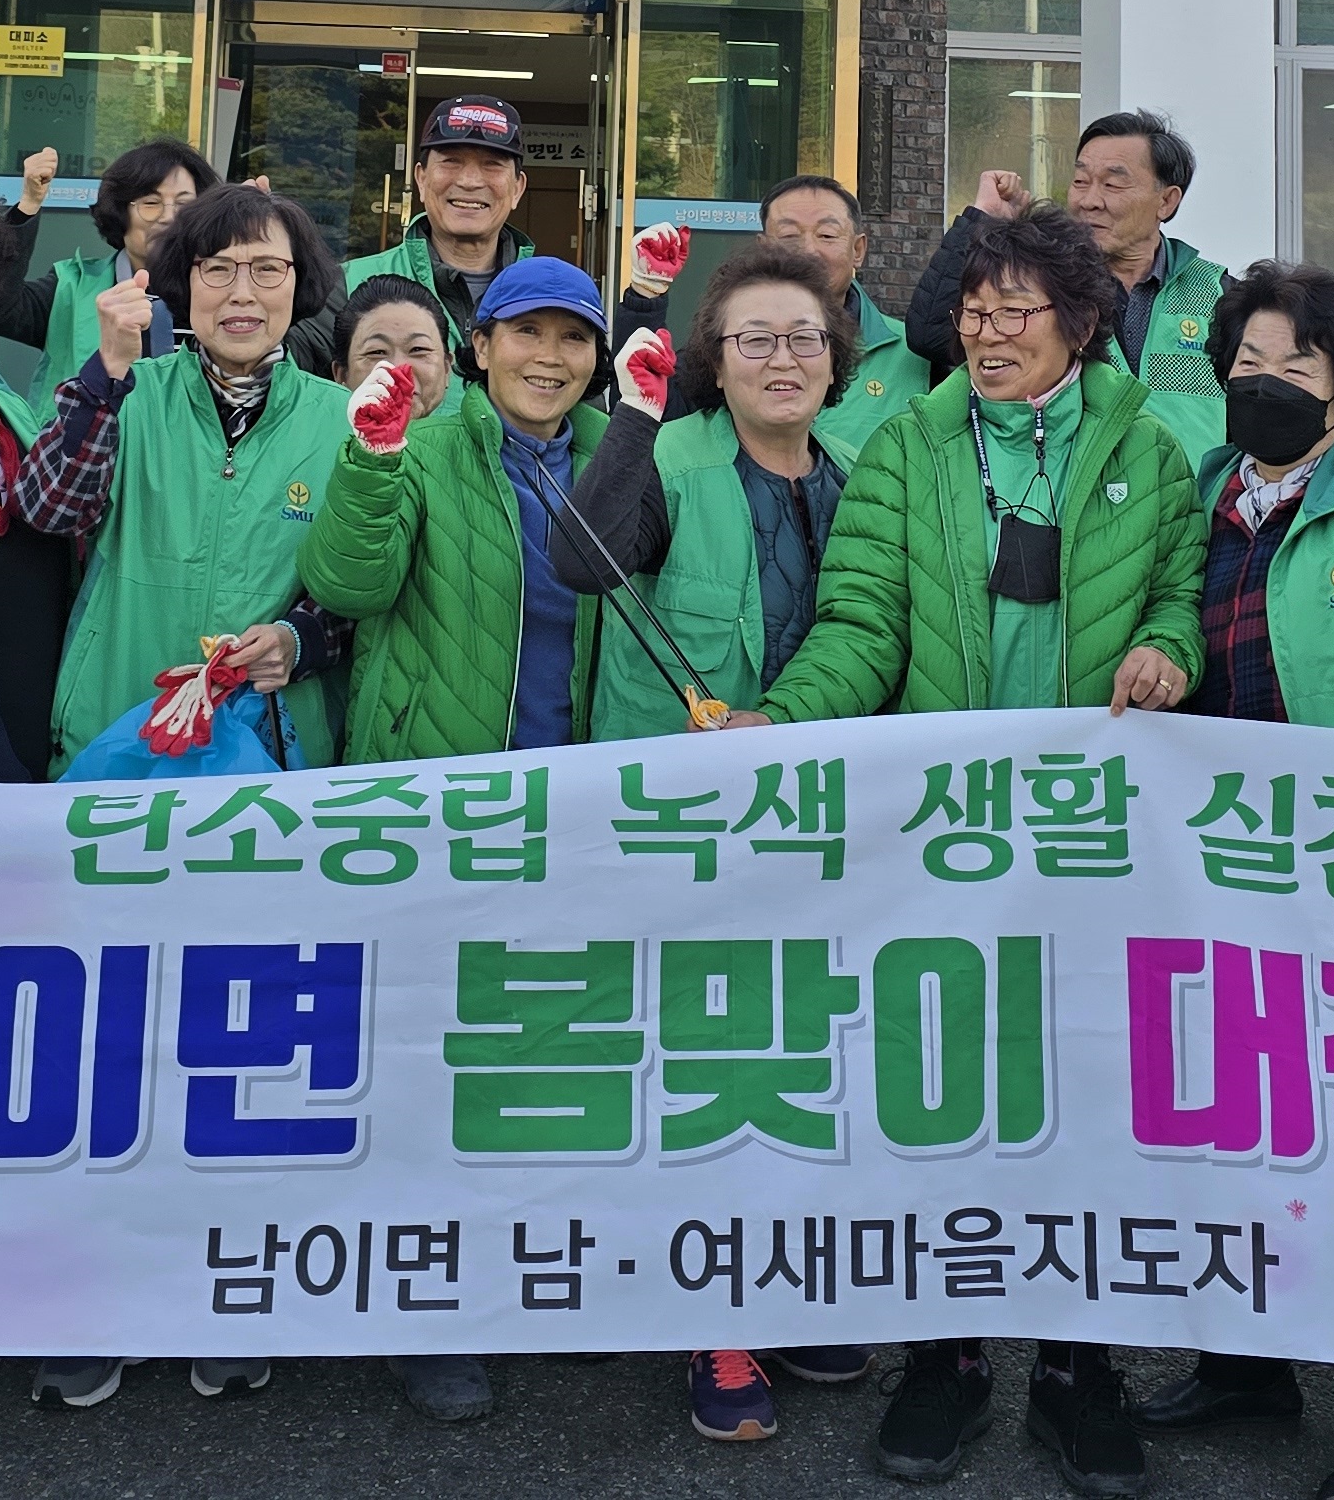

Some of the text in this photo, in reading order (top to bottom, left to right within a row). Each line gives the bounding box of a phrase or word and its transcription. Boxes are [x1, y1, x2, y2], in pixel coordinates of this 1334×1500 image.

[9, 30, 49, 43] 대피소
[12, 44, 44, 52] SHELTER
[1177, 339, 1203, 350] SMU
[280, 507, 315, 523] SMU
[65, 766, 550, 886] 탄소중립
[610, 757, 848, 883] 녹색
[899, 753, 1140, 883] 생활
[442, 935, 1046, 1156] 봄맞이
[206, 1219, 461, 1315] 남이면
